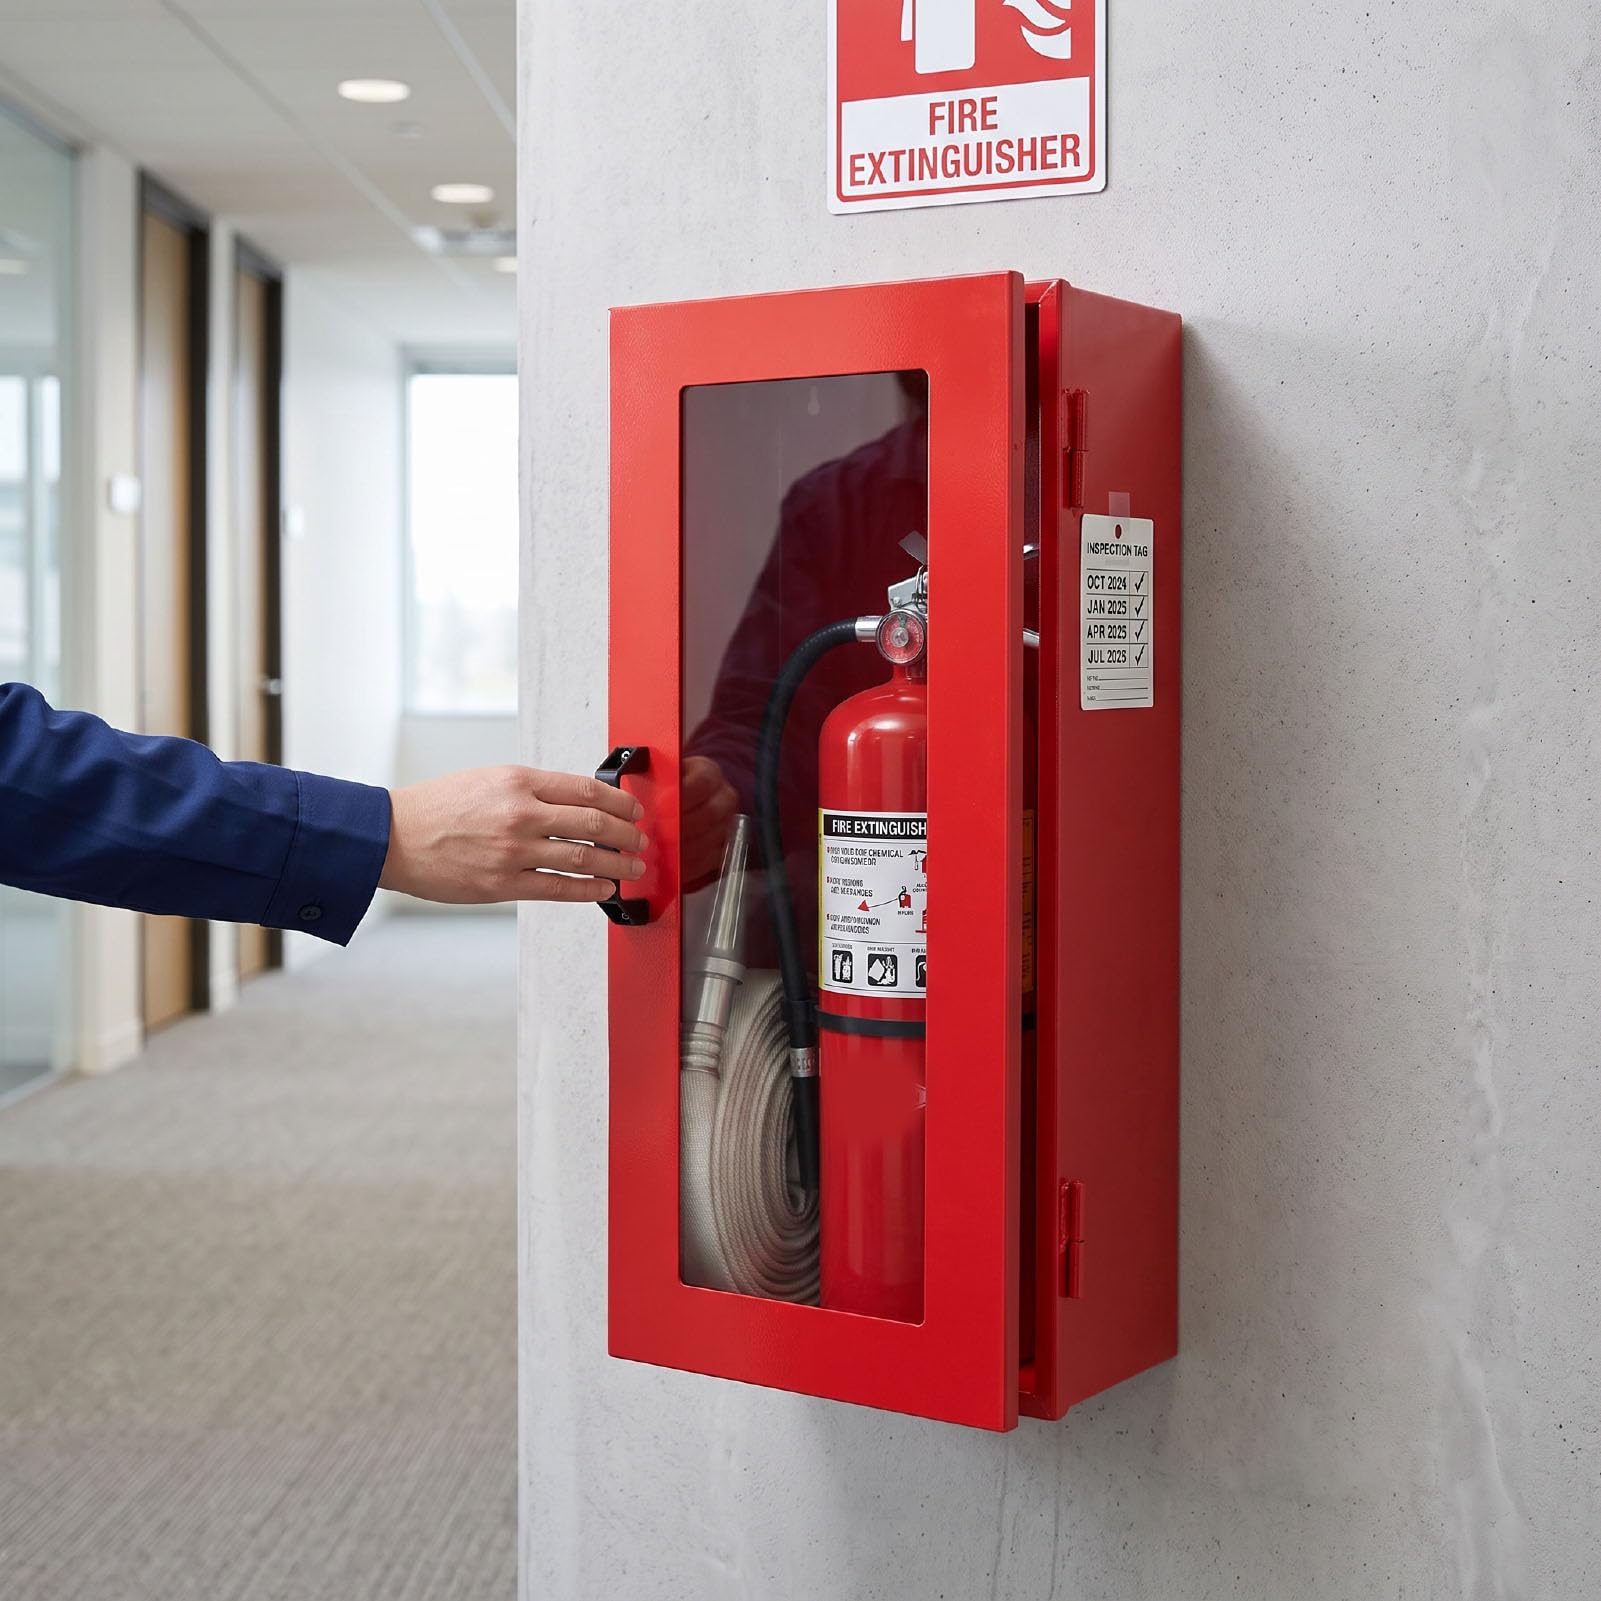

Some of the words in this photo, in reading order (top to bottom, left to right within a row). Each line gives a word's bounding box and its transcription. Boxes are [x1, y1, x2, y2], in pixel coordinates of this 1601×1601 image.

[929, 96, 998, 136] FIRE
[849, 133, 1081, 187] EXTINGUISHER
[1087, 542, 1132, 556] INSPECTION
[1133, 545, 1148, 557] TAG
[1087, 574, 1105, 590] OCT
[1107, 575, 1127, 591] 2024
[1087, 599, 1105, 614] JAN
[1107, 600, 1127, 615] 2025
[1087, 624, 1106, 639] APR
[1107, 624, 1127, 639] 2025
[1087, 649, 1105, 664] JUL
[1106, 649, 1127, 664] 2025
[832, 819, 852, 833] FIRE
[854, 820, 927, 836] EXTINGUISH
[868, 849, 904, 858] CHEMICAL
